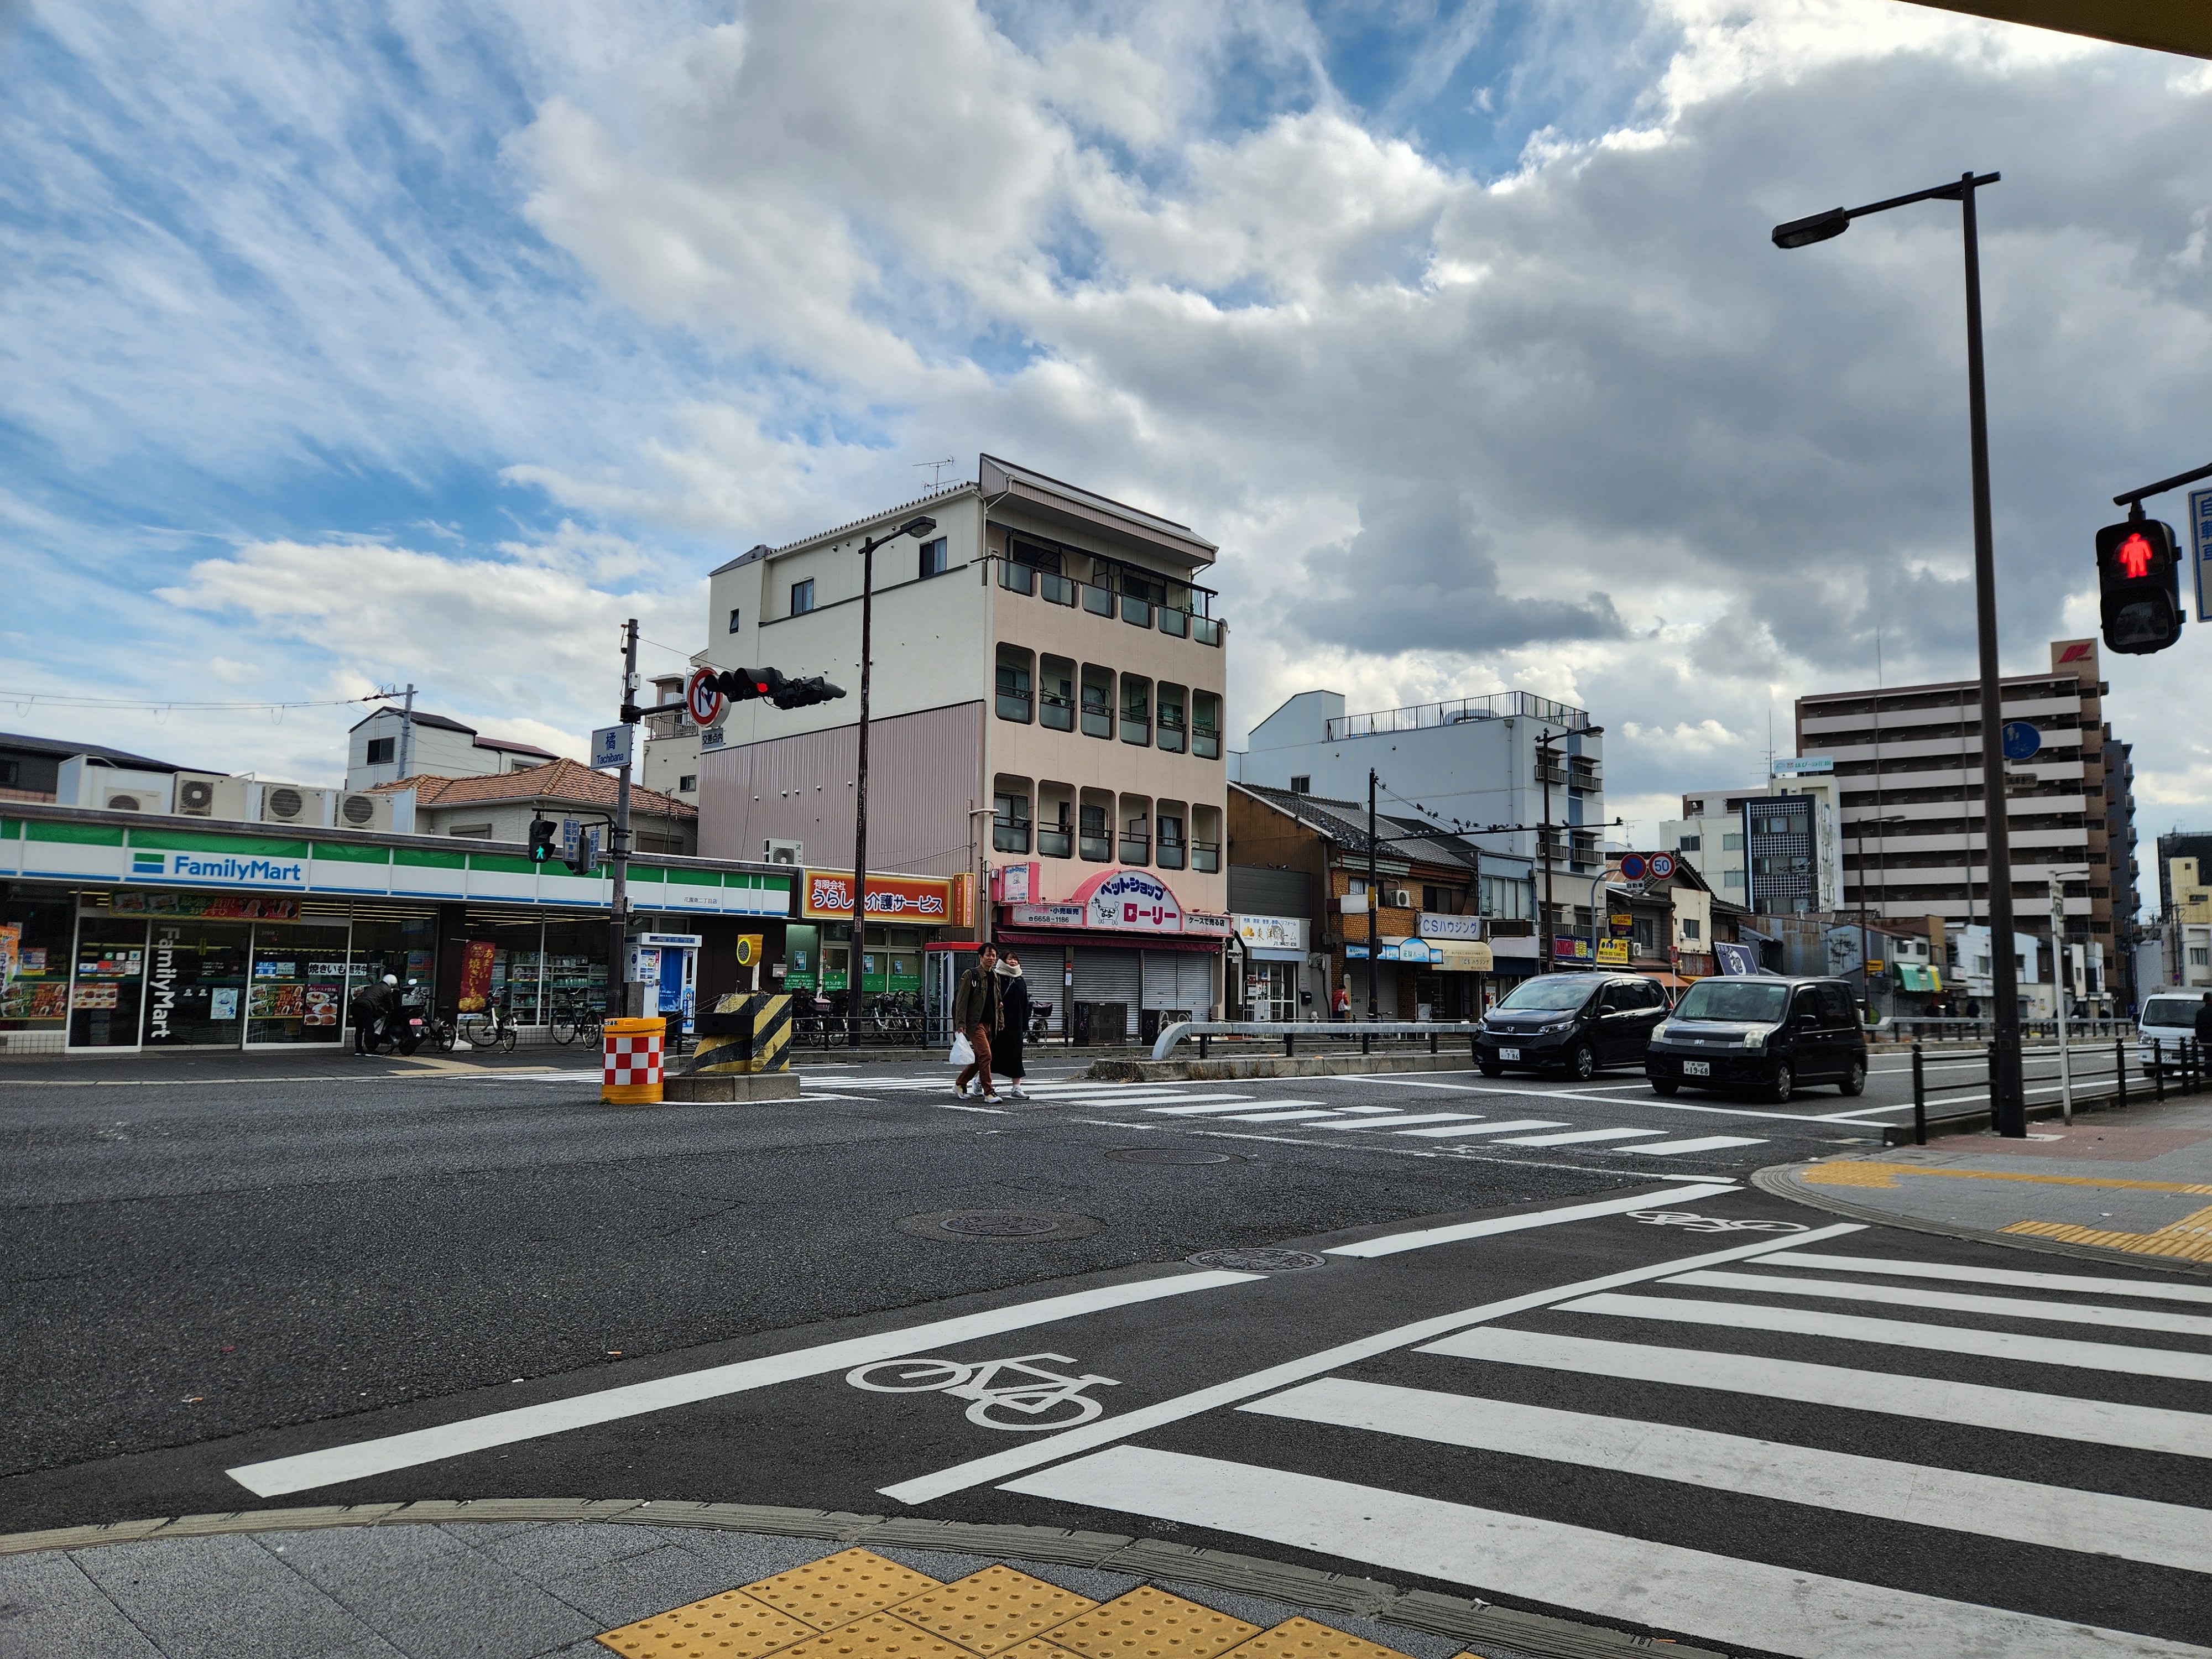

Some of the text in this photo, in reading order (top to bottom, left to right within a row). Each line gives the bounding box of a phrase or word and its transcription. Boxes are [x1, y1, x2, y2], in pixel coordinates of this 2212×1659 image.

[606, 732, 616, 750] 橘
[702, 734, 723, 744] 交差点内
[597, 752, 624, 764] Tachibana
[174, 855, 301, 881] FamilyMart
[1655, 860, 1670, 872] 50
[813, 878, 846, 891] 有限会社
[1101, 877, 1164, 901] ペットショップ
[684, 896, 717, 905] 花園南二丁目店
[812, 889, 943, 913] うらし介護サービス
[1124, 903, 1177, 925] ローリー
[1189, 917, 1224, 926] ケースで売る店
[1423, 919, 1477, 933] CSハウジング
[149, 927, 180, 1037] FamilyMart
